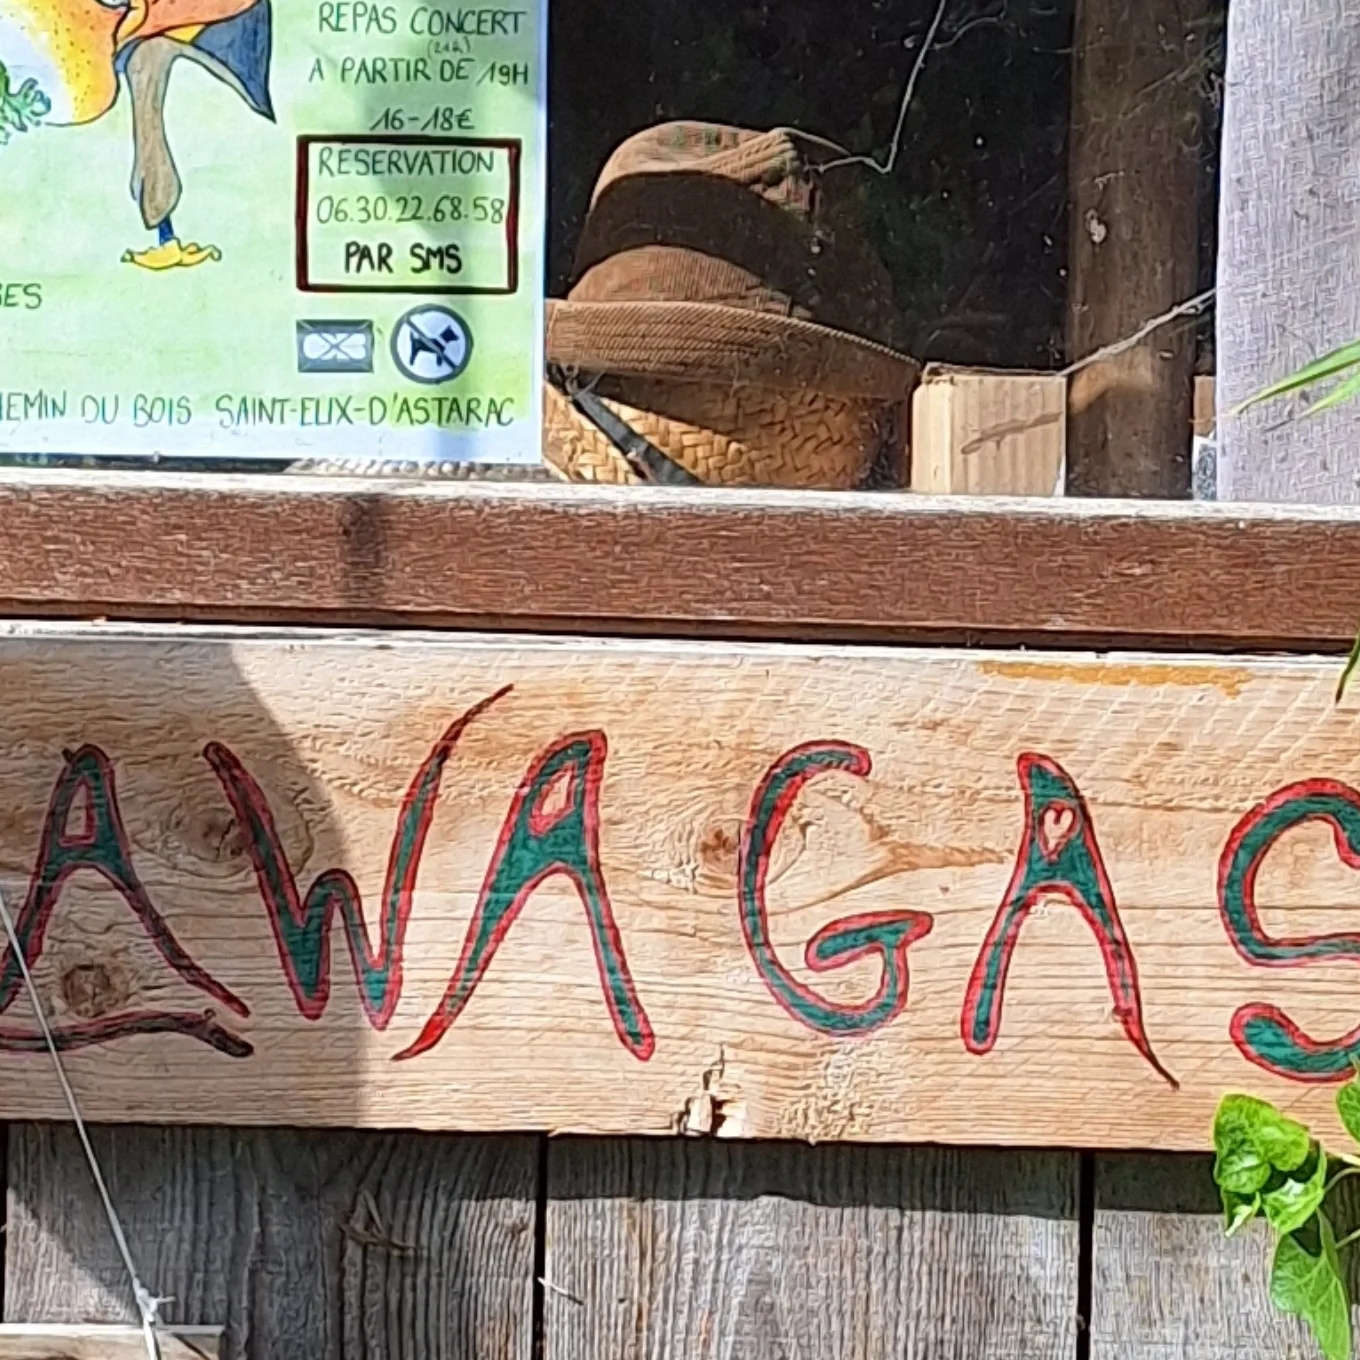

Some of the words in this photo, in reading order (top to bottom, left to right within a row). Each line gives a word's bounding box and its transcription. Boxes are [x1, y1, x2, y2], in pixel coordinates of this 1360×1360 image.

[318, 0, 397, 34] REPAS
[410, 6, 528, 36] CONCERT
[308, 57, 325, 83] A
[340, 56, 432, 84] PARTIR
[439, 57, 475, 83] DE
[476, 60, 529, 85] 19H
[369, 106, 476, 131] 16-18€
[316, 194, 506, 225] 06.30.22.68.58
[344, 240, 394, 274] PAR
[409, 242, 463, 274] SMS
[81, 393, 120, 424] DU
[133, 394, 193, 428] BOIS
